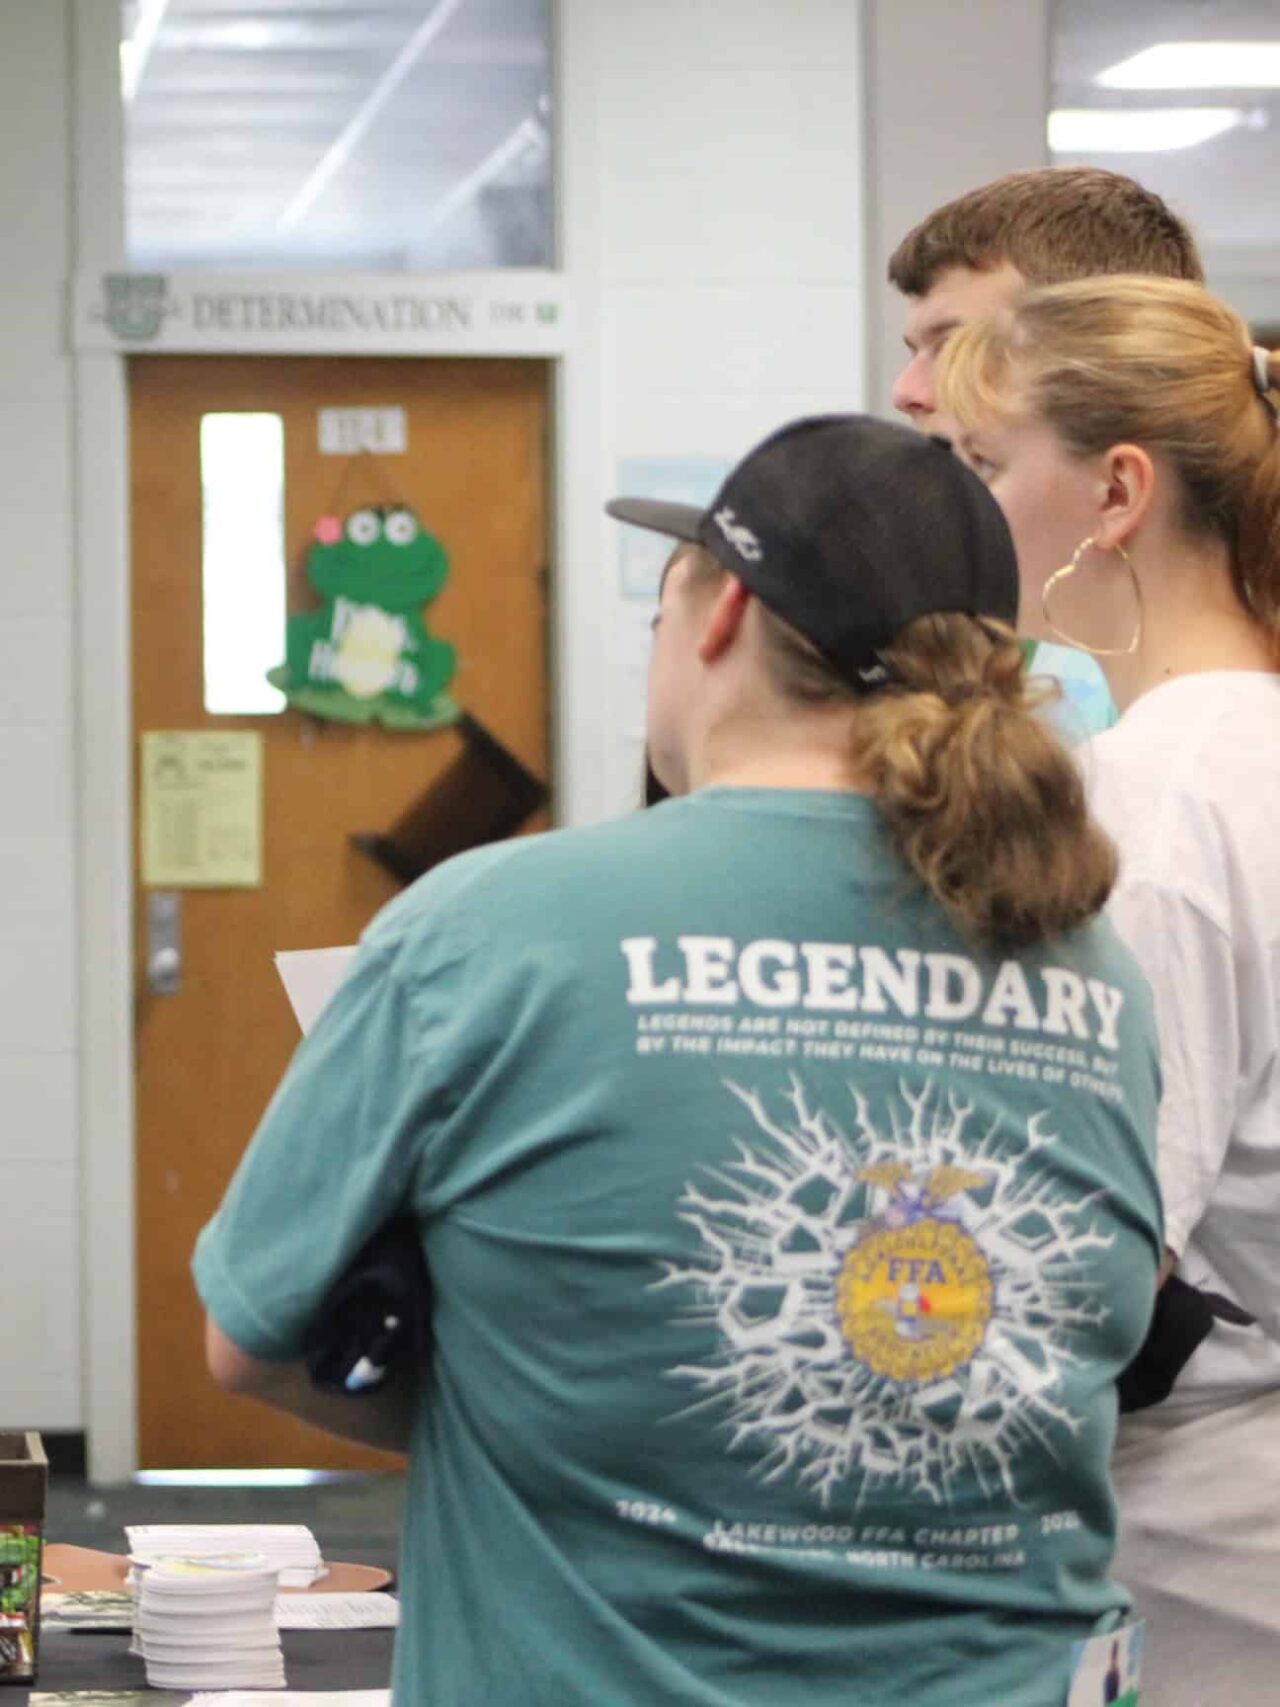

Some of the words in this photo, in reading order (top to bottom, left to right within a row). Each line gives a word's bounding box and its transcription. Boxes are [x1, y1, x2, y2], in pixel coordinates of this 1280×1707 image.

[193, 293, 471, 332] DETERMINATION
[621, 935, 1124, 1049] LEGENDARY
[637, 1013, 733, 1034] LEGENDS
[737, 1016, 780, 1034] ARE
[785, 1018, 829, 1036] NOT
[834, 1020, 918, 1043] DEFINED
[924, 1028, 949, 1044] BY
[954, 1032, 1004, 1052] THEIR
[636, 1034, 666, 1054] BY
[672, 1035, 713, 1054] THE
[717, 1038, 797, 1055] IMPACT
[803, 1041, 854, 1058] THEY
[859, 1044, 913, 1063] HAVE
[917, 1050, 944, 1066] ON
[949, 1053, 984, 1072] THE
[988, 1059, 1039, 1080] LIVES
[1043, 1066, 1066, 1083] OF
[888, 1258, 946, 1284] FFA
[714, 1519, 854, 1543] LAKEWOOD
[861, 1526, 905, 1542] FFA
[913, 1524, 1019, 1546] CHAPTER
[846, 1550, 915, 1568] NORTH
[920, 1550, 1027, 1569] CAROLINA
